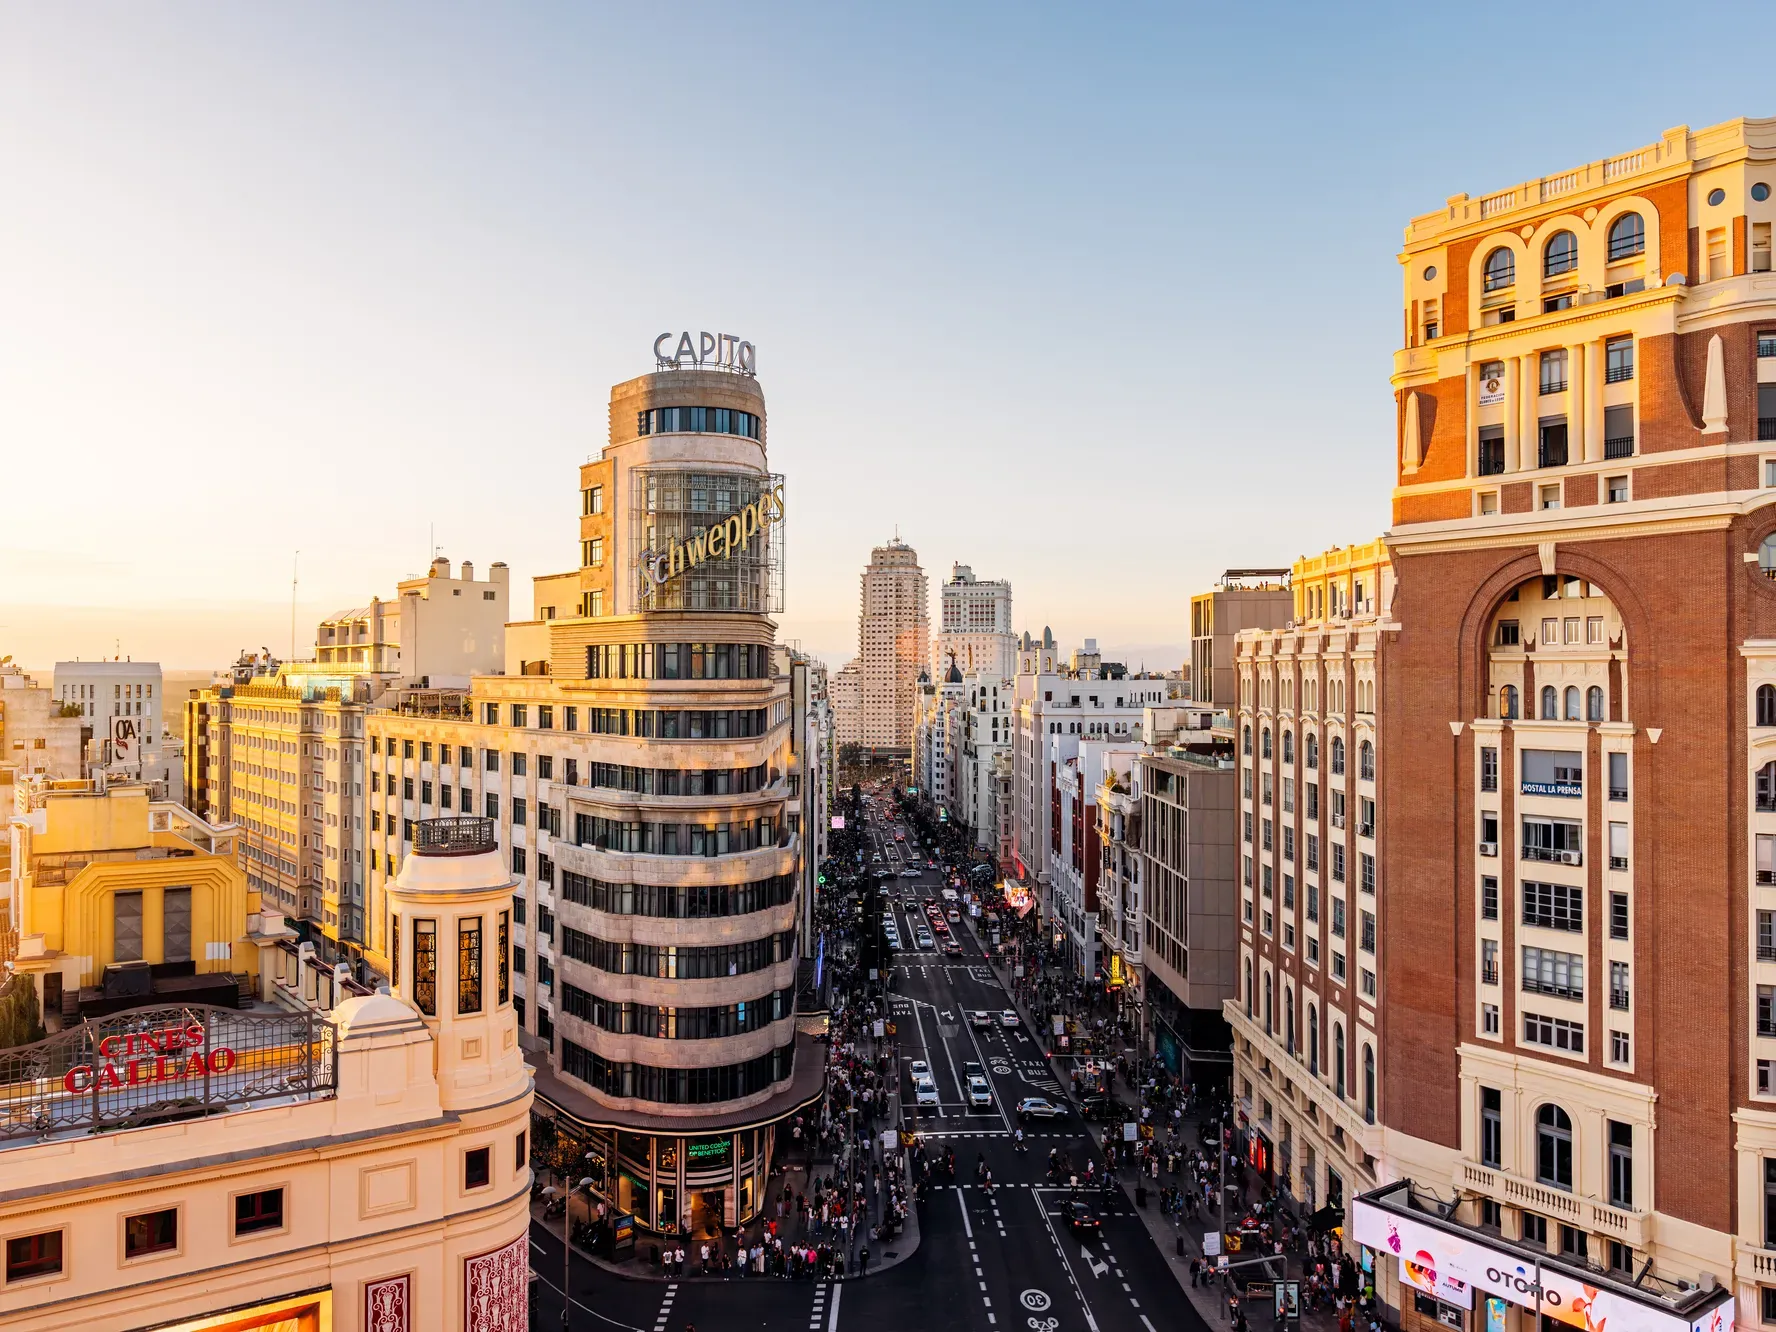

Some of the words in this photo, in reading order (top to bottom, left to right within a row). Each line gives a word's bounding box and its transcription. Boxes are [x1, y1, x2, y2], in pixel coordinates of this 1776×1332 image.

[638, 484, 785, 599] Schweppes
[826, 773, 834, 832] EMPERADOR
[1522, 783, 1547, 793] HOSTAL
[1547, 785, 1557, 793] LA
[1556, 786, 1582, 795] PRENSA
[100, 1025, 205, 1059] CINES
[64, 1047, 236, 1094] CALLAO
[1026, 1294, 1045, 1306] 30
[1442, 1281, 1463, 1293] AUTUMN
